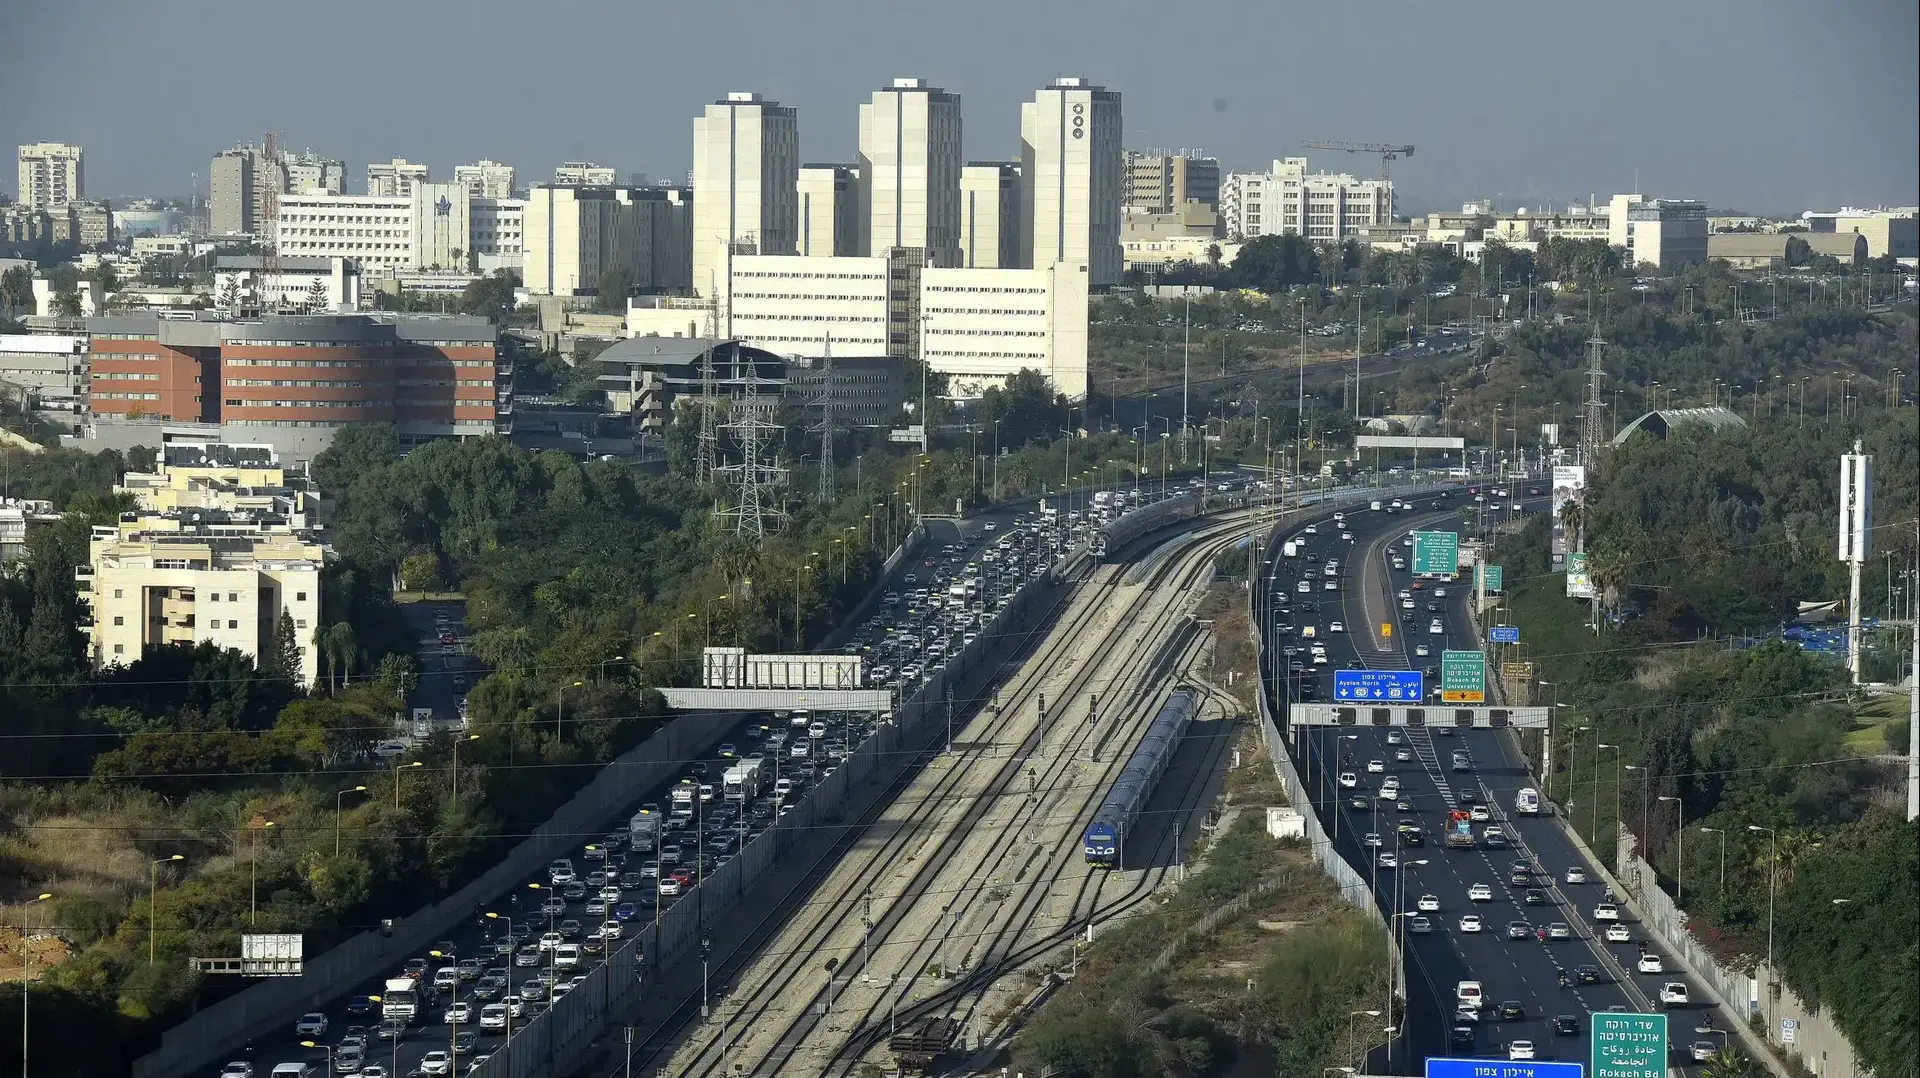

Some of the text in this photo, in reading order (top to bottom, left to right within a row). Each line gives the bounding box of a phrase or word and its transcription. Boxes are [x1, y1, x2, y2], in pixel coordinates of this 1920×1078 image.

[1605, 1020, 1654, 1030] שדי רוקח
[1599, 1032, 1659, 1042] אוניברסיטה
[1634, 1045, 1657, 1056] جادة
[1611, 1057, 1648, 1067] الجامعة
[1474, 1067, 1535, 1077] איילון צפון
[1599, 1068, 1659, 1078] Rokach Bd
